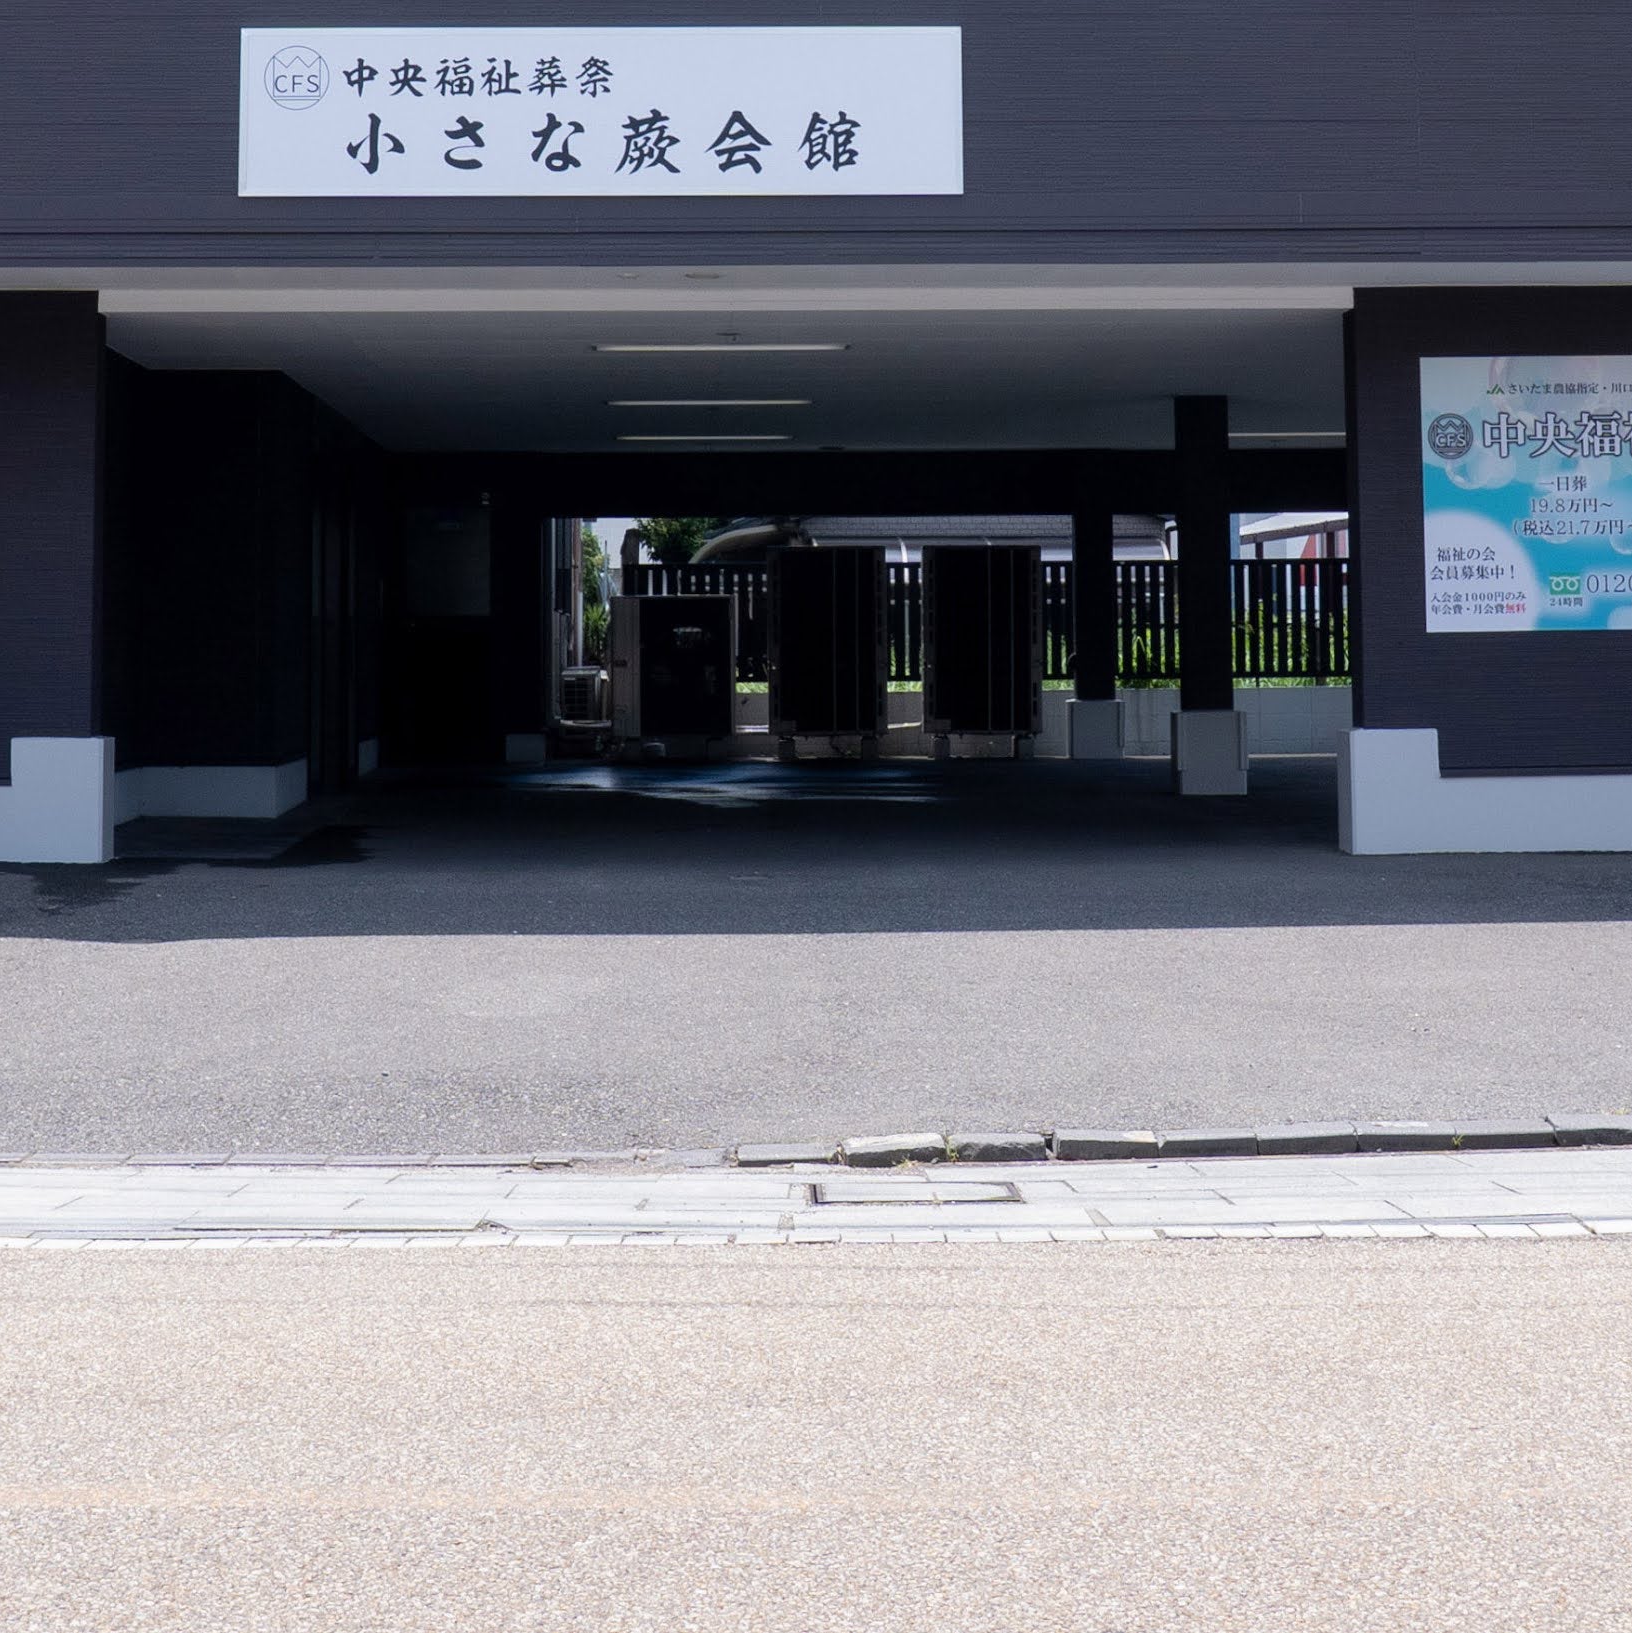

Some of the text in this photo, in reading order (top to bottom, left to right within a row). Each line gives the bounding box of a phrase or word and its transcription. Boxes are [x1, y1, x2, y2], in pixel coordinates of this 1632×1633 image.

[274, 74, 320, 93] CFS
[342, 55, 615, 98] 中央福祉葬祭
[346, 109, 862, 175] 小さな蕨会館
[1435, 433, 1466, 448] CFS
[1538, 475, 1587, 492] 一日葬
[1437, 546, 1496, 562] 福祉の会
